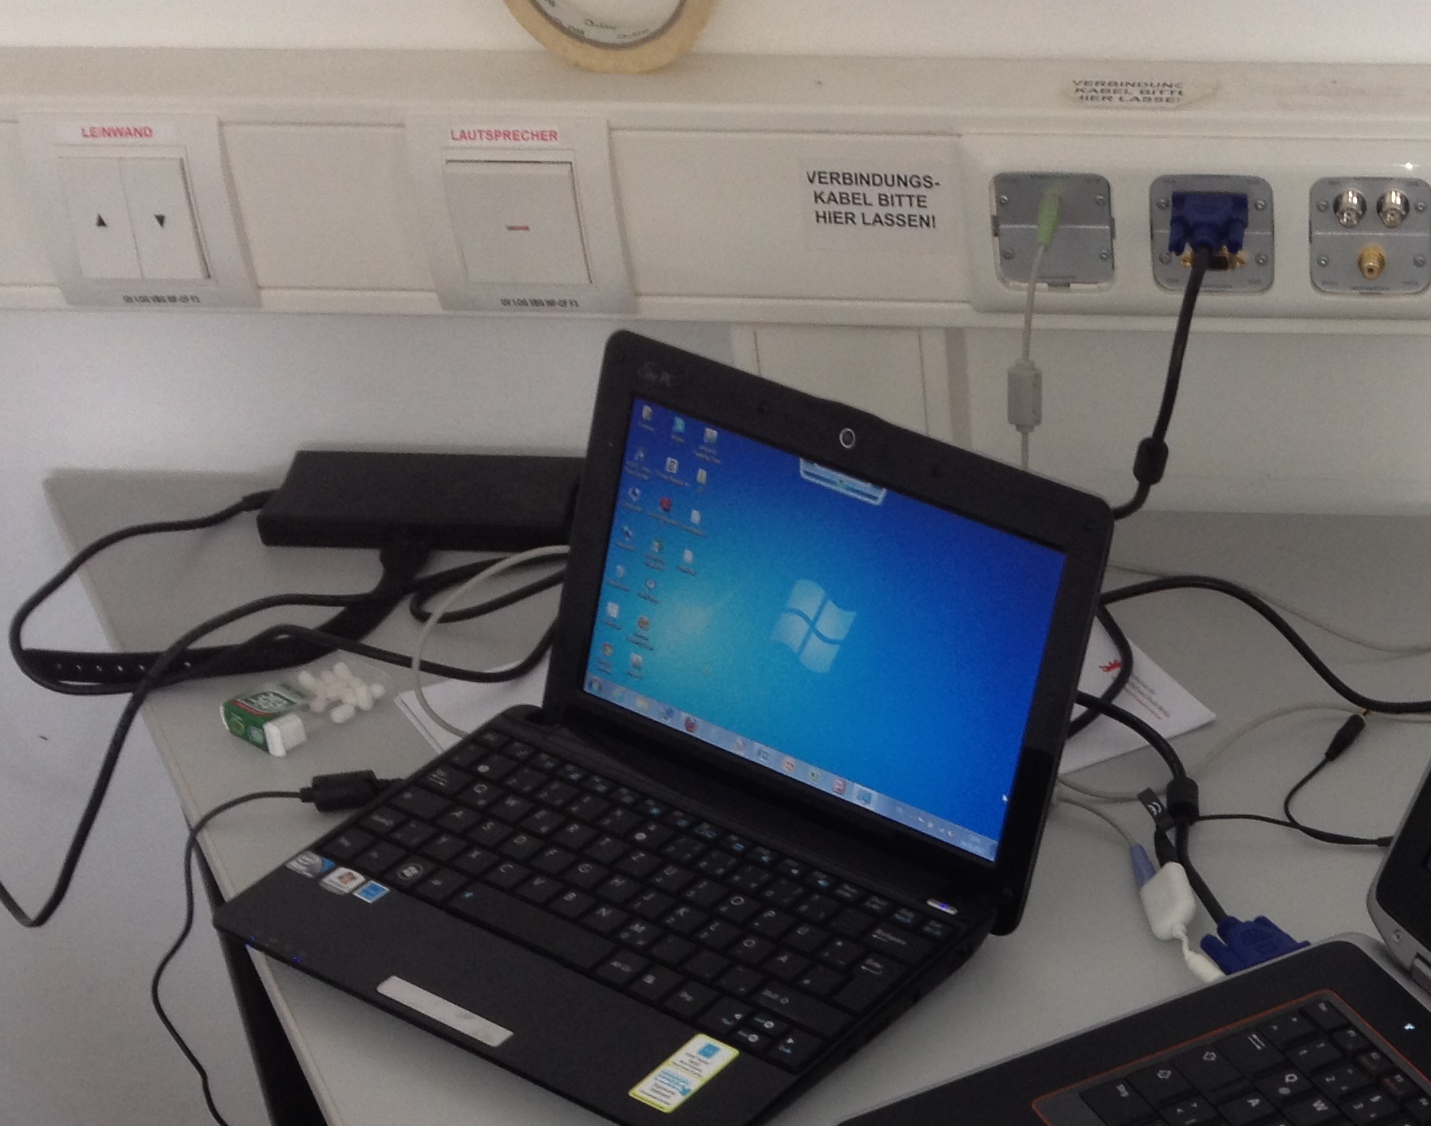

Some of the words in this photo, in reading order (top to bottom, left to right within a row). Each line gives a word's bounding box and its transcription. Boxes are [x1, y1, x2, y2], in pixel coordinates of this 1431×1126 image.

[81, 126, 154, 139] LEINWAND
[450, 129, 560, 142] LAUTSPRECHER
[806, 170, 941, 189] VERBINDUNGS-
[813, 191, 873, 206] KABEL
[878, 193, 928, 209] BITTE
[815, 210, 857, 225] HIER
[861, 212, 937, 229] LASSEN!
[1284, 1073, 1298, 1083] Q
[1247, 1098, 1260, 1108] A
[1312, 1099, 1328, 1111] W
